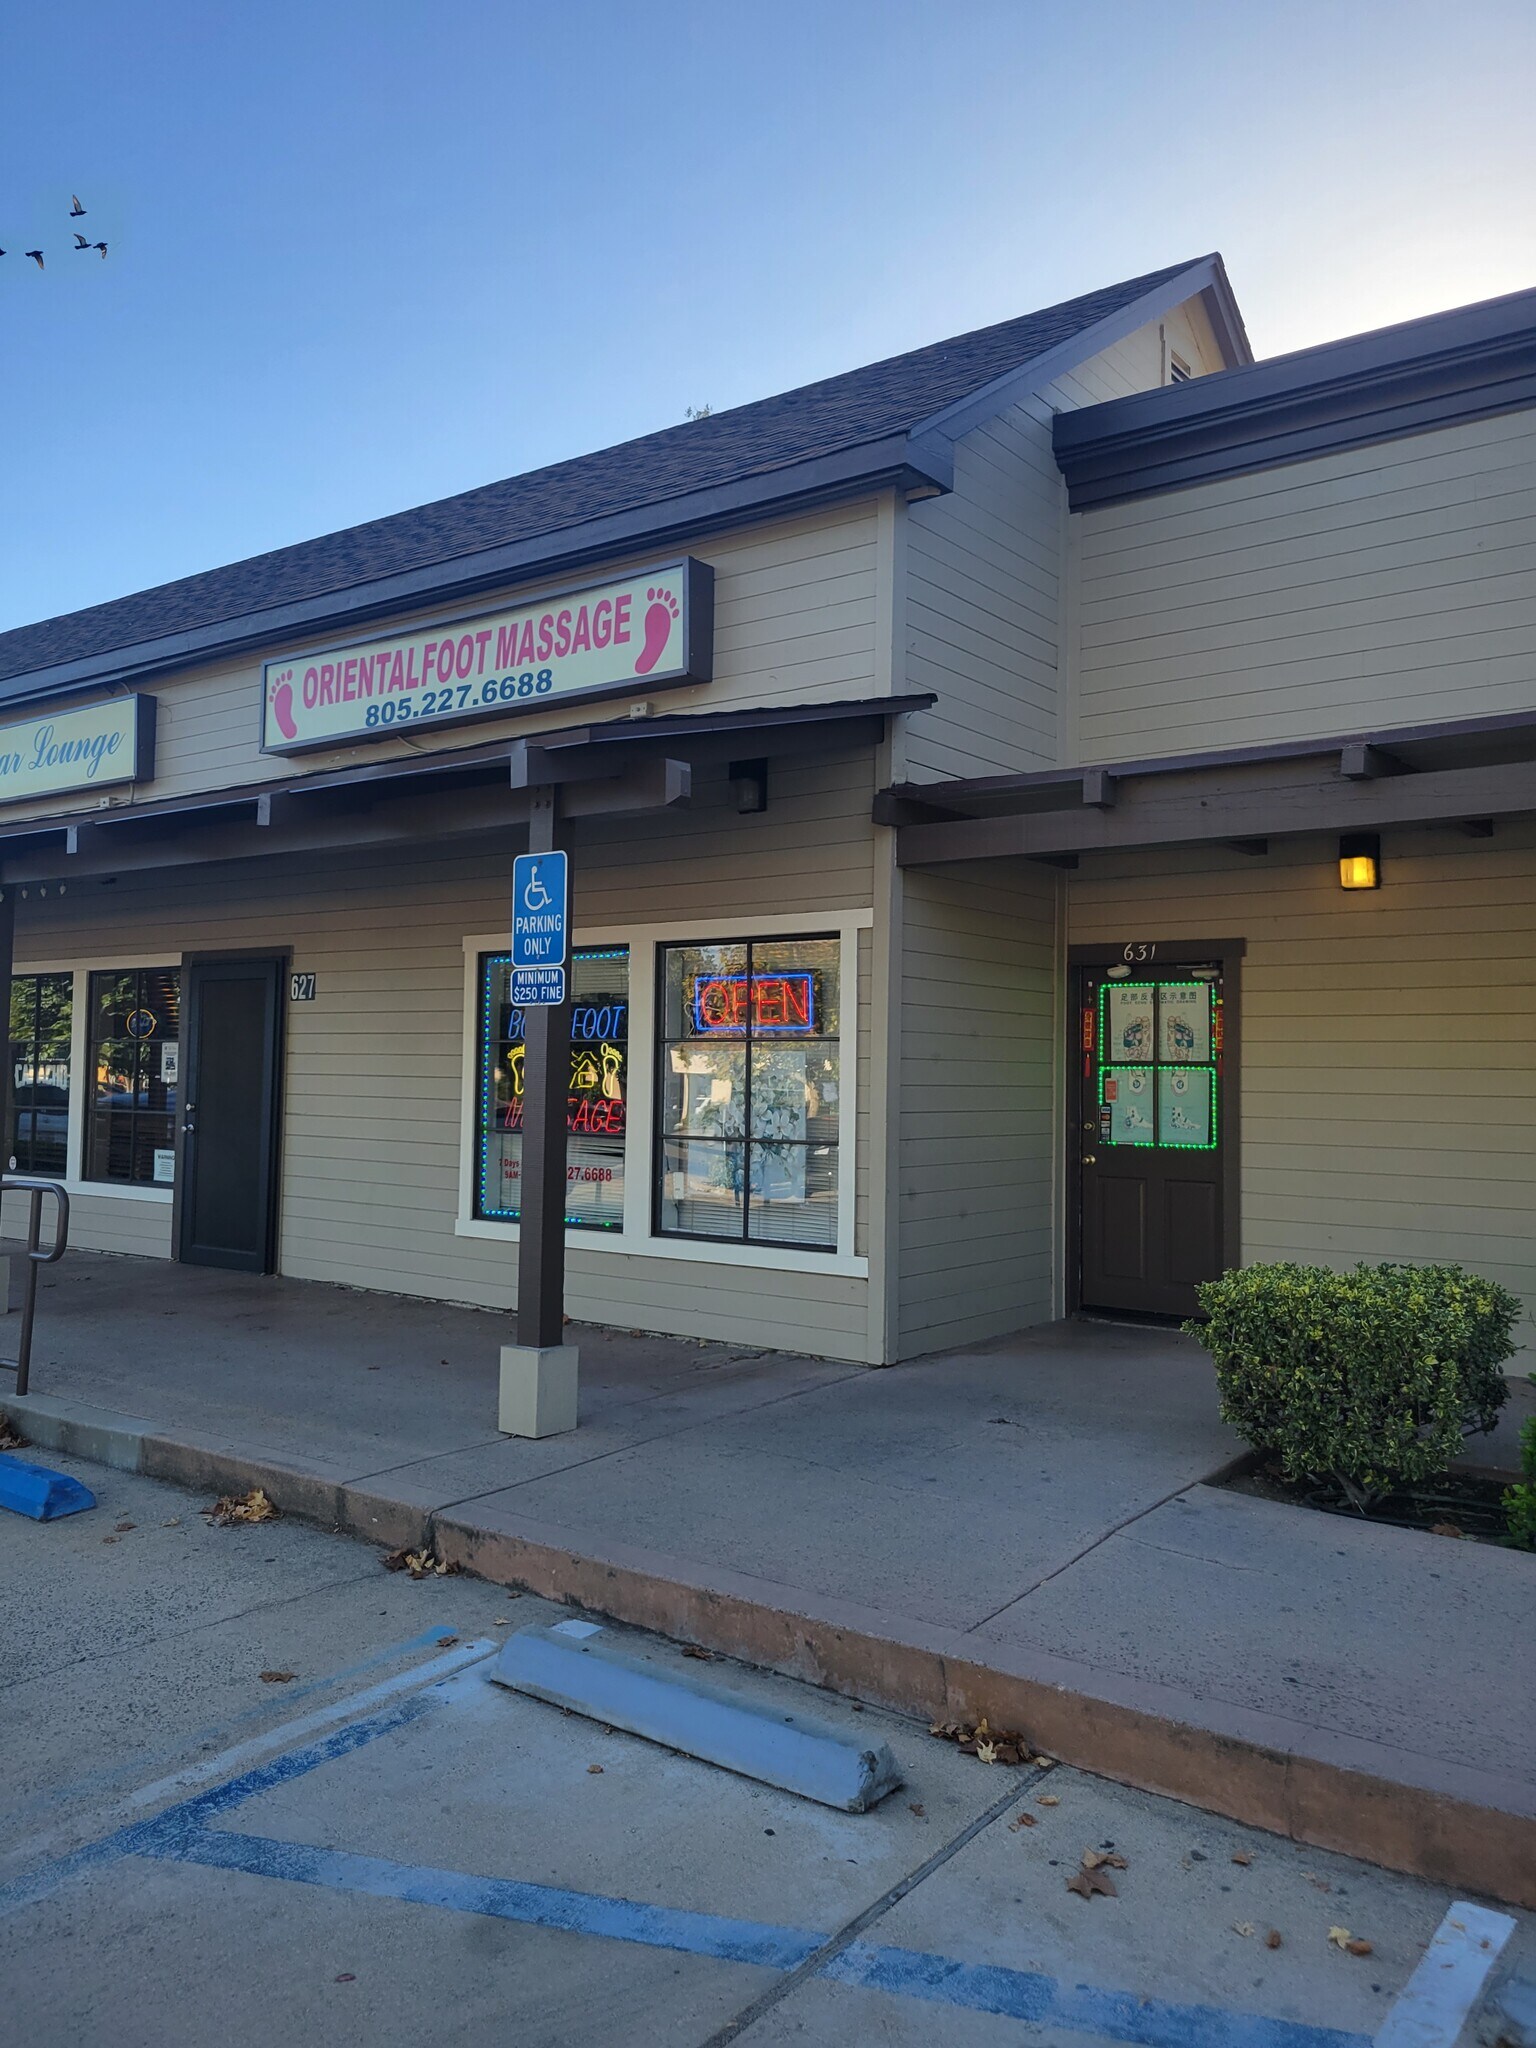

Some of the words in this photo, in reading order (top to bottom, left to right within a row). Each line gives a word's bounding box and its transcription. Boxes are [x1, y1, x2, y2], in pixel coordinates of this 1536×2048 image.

[303, 650, 420, 710] ORIENTAL
[421, 630, 492, 687] FOOT
[499, 594, 632, 670] MASSAGE
[364, 668, 553, 728] 805.227.6688
[28, 724, 126, 779] Lounge
[516, 914, 562, 934] PARKING
[524, 937, 552, 956] ONLY
[1123, 943, 1156, 961] 631
[291, 975, 315, 1000] 627
[517, 970, 559, 985] MINIMUM
[514, 986, 538, 1002] $250
[541, 985, 562, 1000] FINE
[702, 980, 809, 1024] OPEN
[1121, 991, 1197, 1001] 足部反区示意图
[571, 1006, 626, 1039] FOOT
[504, 1096, 623, 1133] MAGE
[504, 1158, 520, 1169] Days
